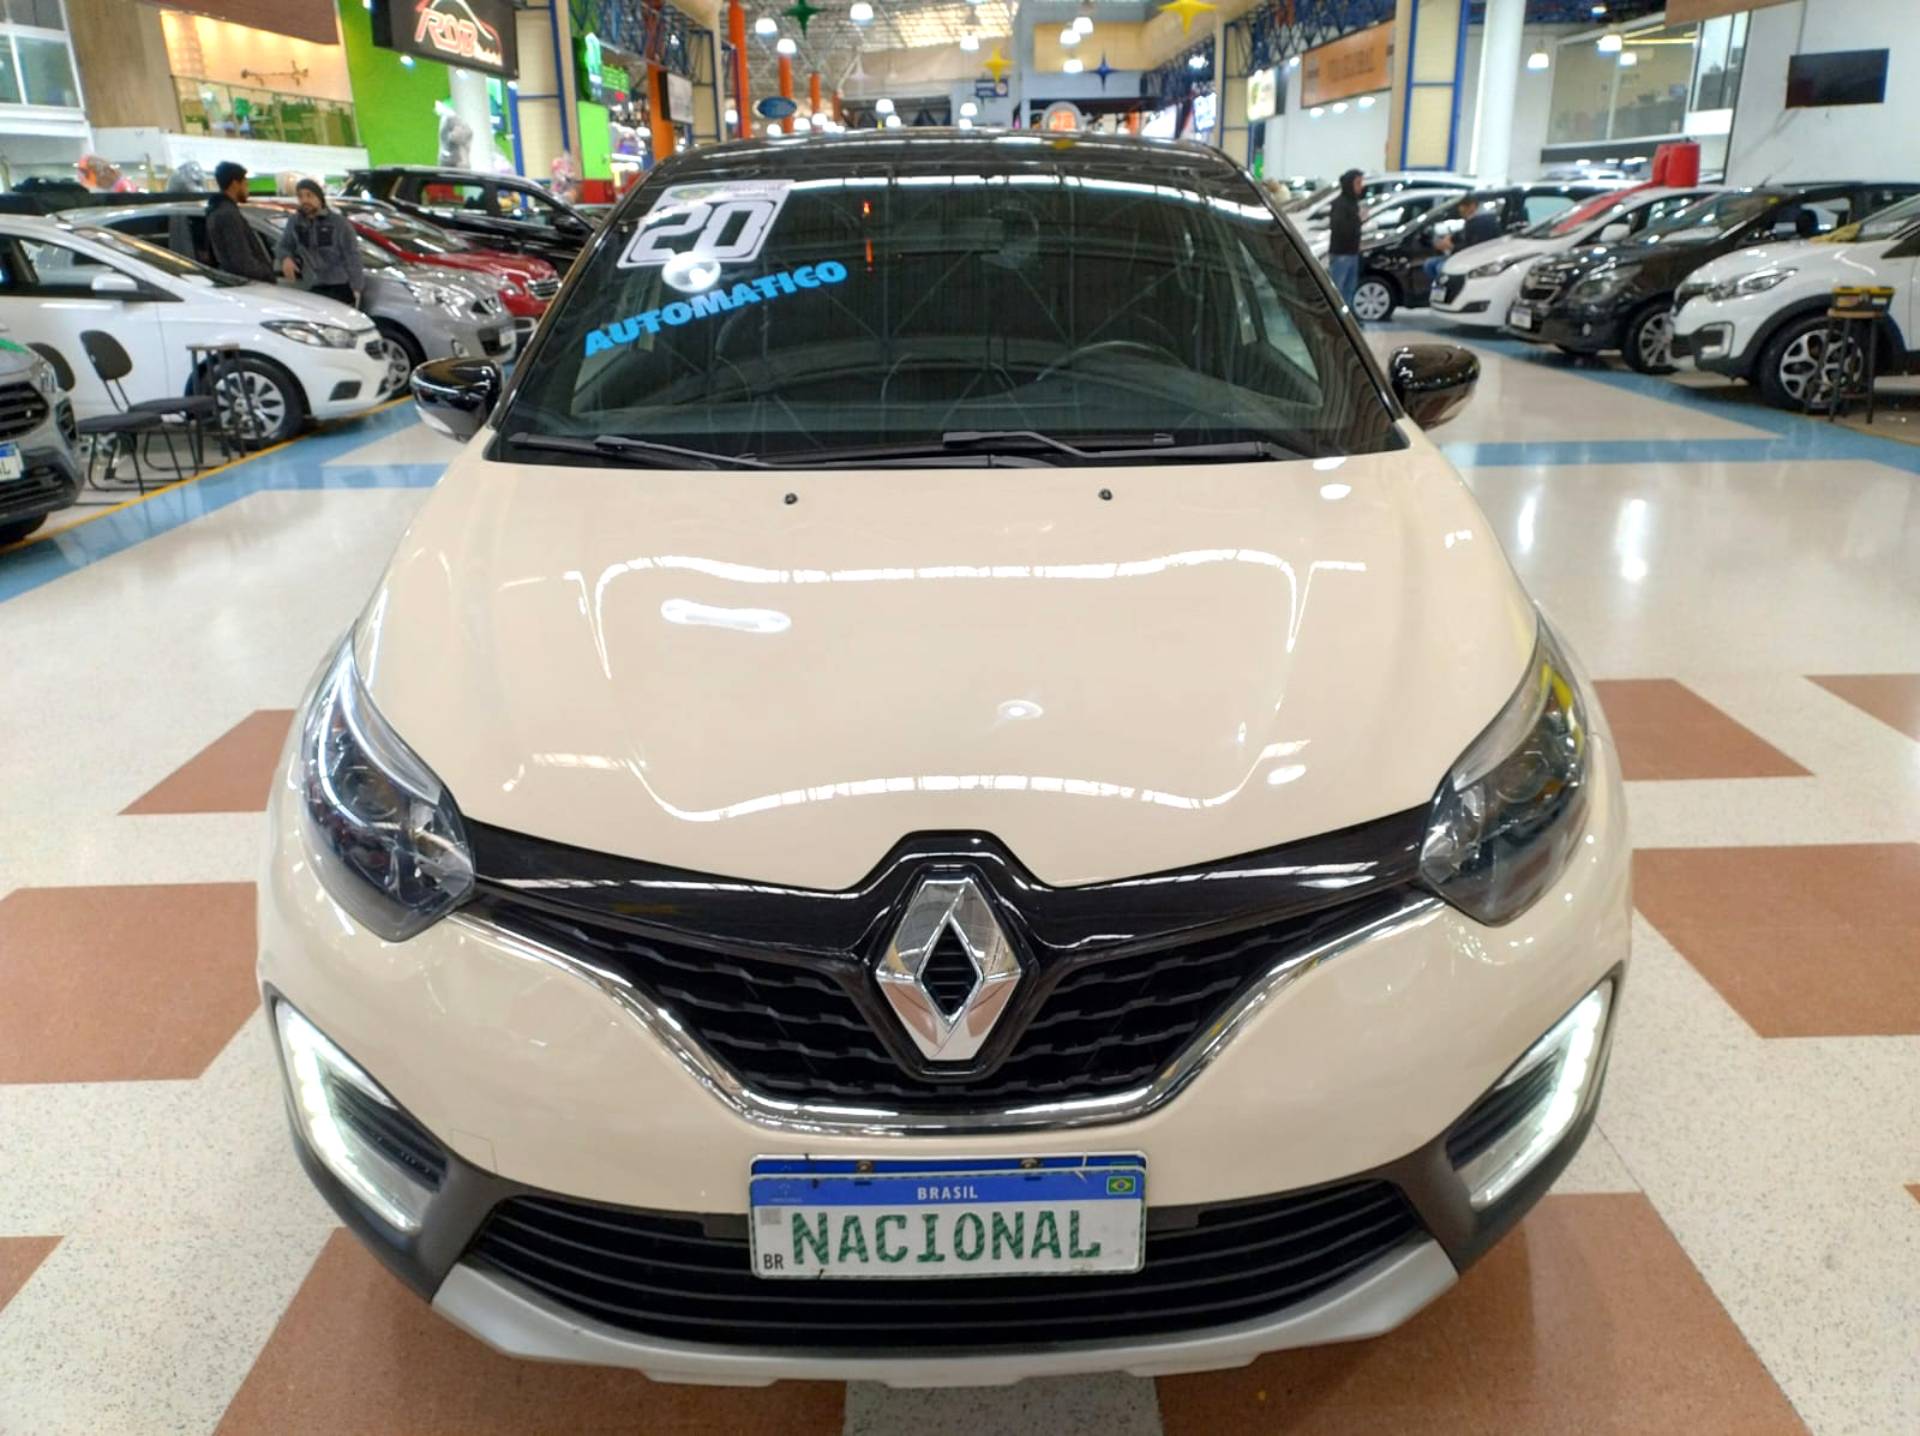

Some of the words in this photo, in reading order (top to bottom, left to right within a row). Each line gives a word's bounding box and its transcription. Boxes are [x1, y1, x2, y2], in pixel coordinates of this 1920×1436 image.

[629, 200, 774, 263] 20
[584, 260, 848, 357] AUTOMATICO
[917, 1186, 978, 1201] BRASIL
[763, 1253, 784, 1270] BR
[791, 1209, 1101, 1265] NACIONAL
